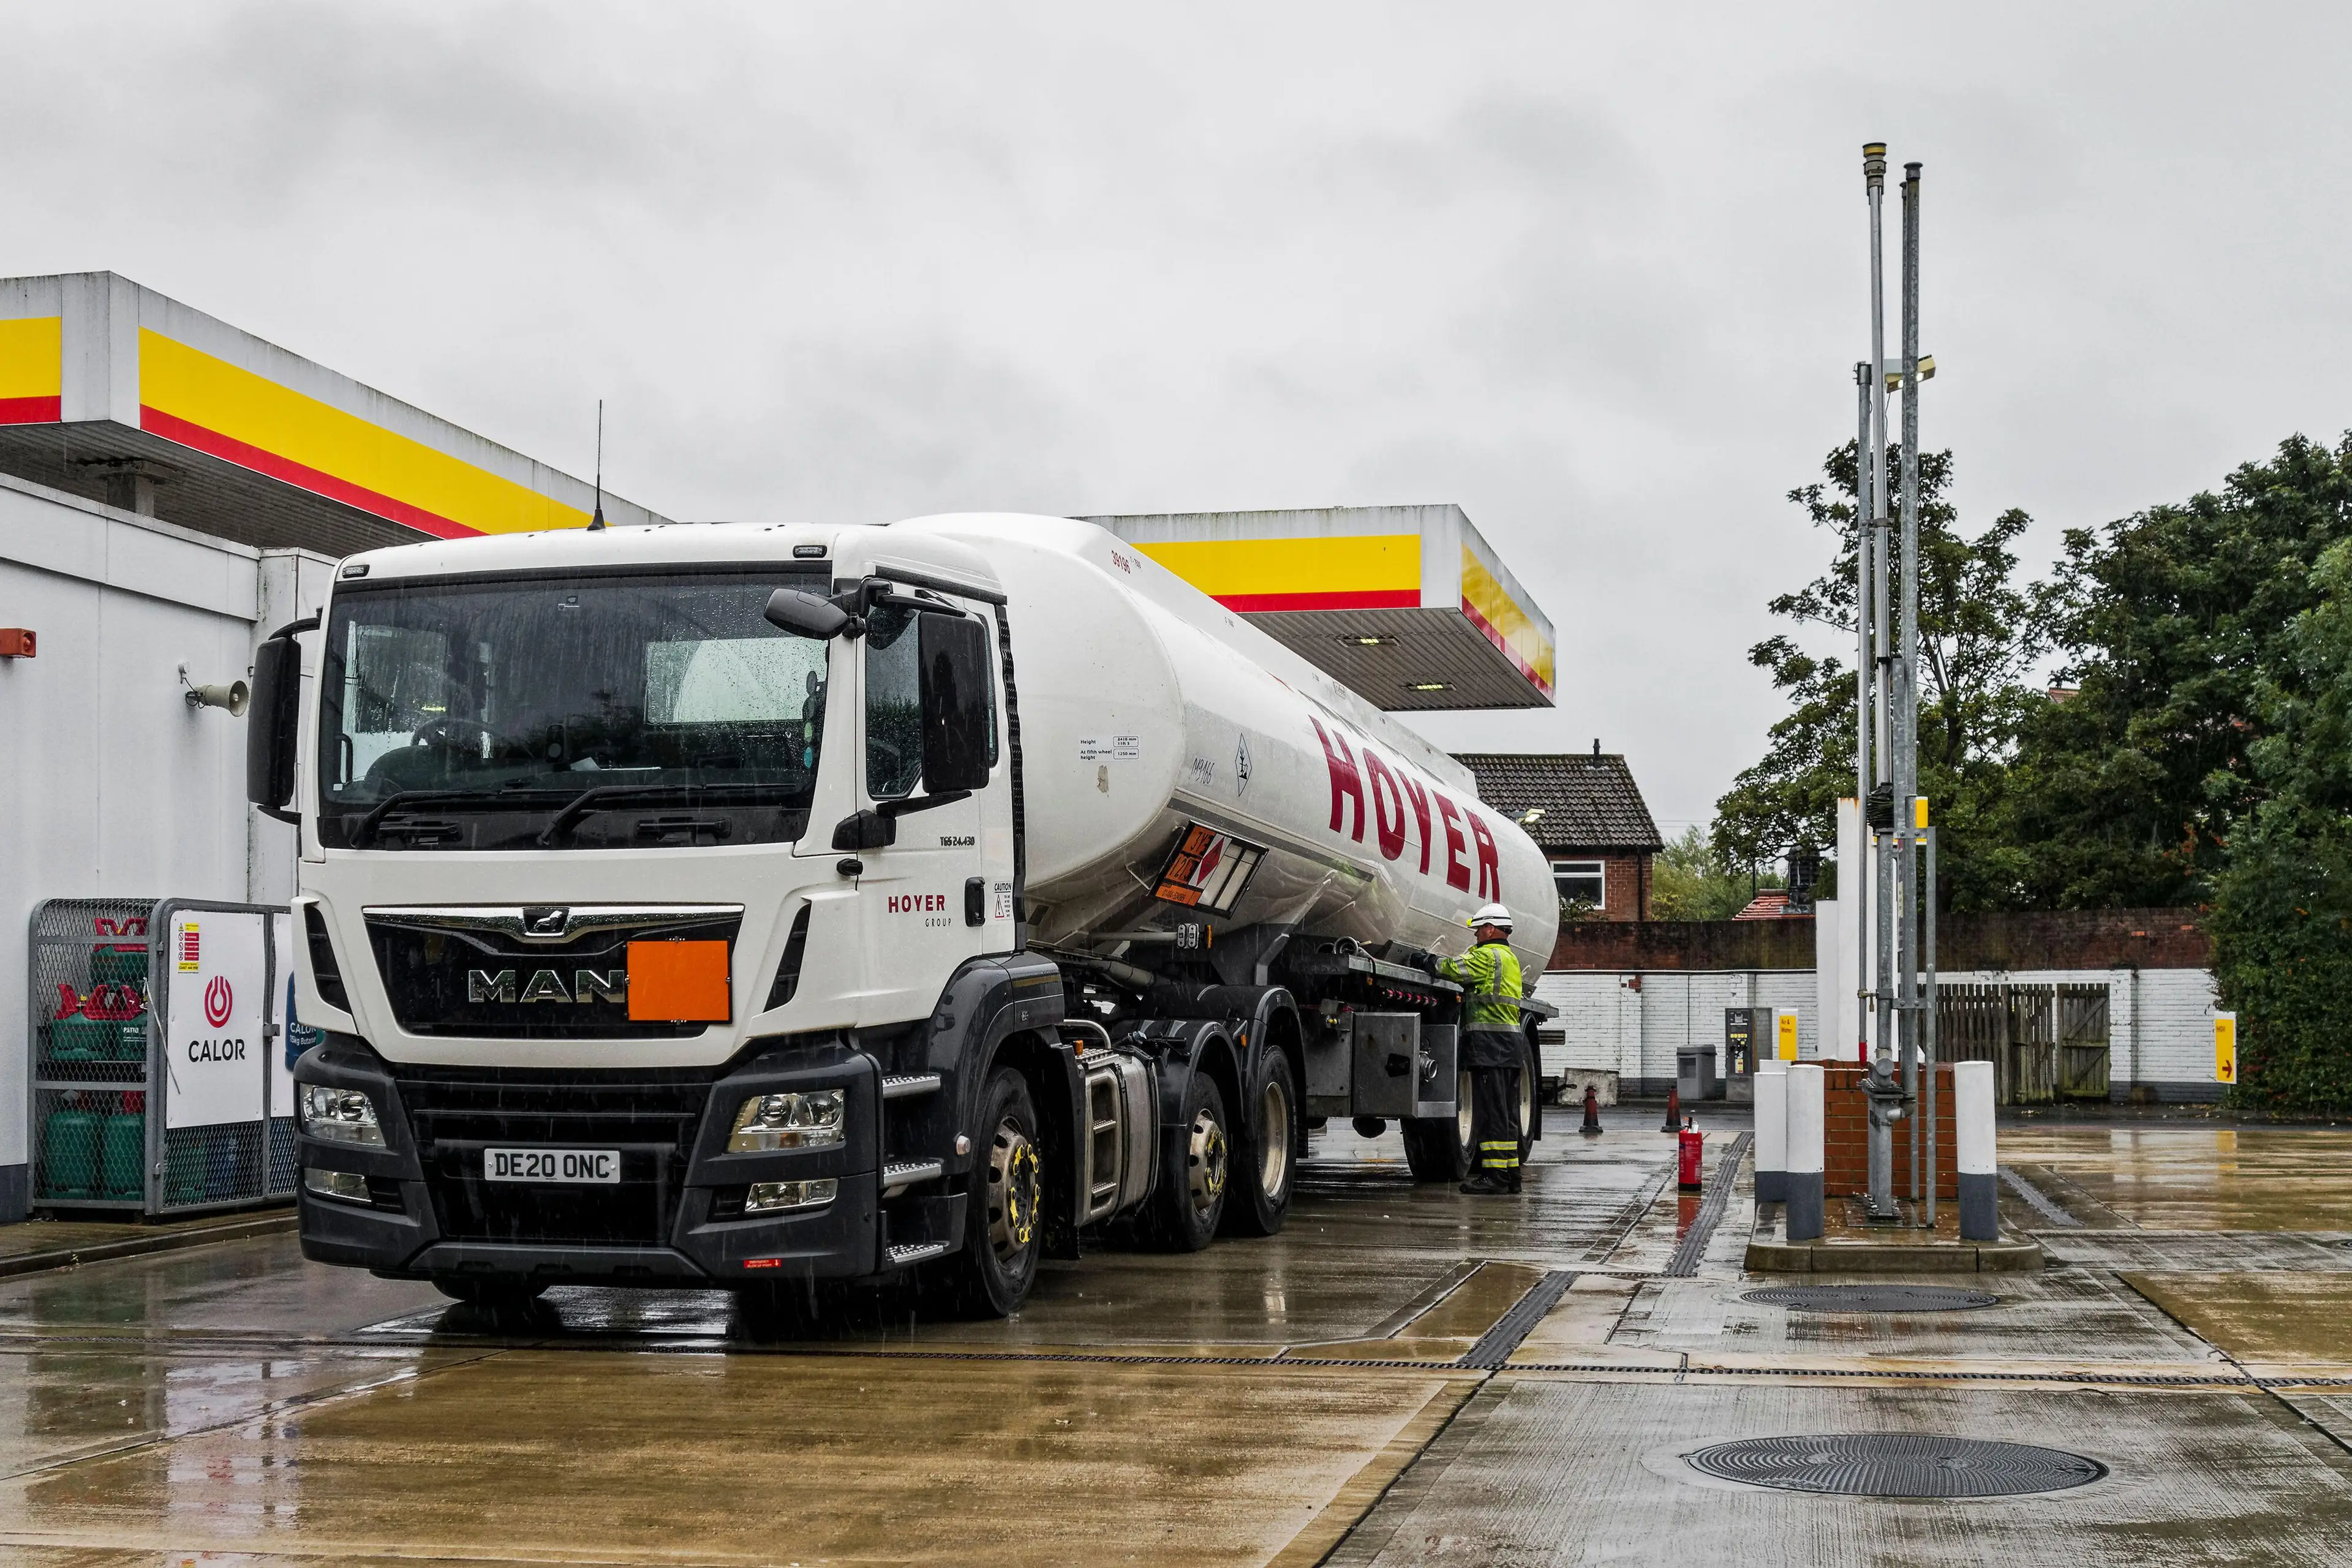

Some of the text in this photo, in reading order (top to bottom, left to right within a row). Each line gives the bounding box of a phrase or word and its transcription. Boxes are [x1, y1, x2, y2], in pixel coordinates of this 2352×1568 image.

[1111, 550, 1131, 574] 39196
[1308, 714, 1500, 904] HOYER
[994, 883, 1012, 891] CAUTION
[888, 894, 945, 913] HOYER
[925, 918, 951, 927] GROUP
[469, 970, 625, 1003] MAN
[188, 1038, 245, 1063] CALOR
[494, 1153, 610, 1178] DE20 ONC
